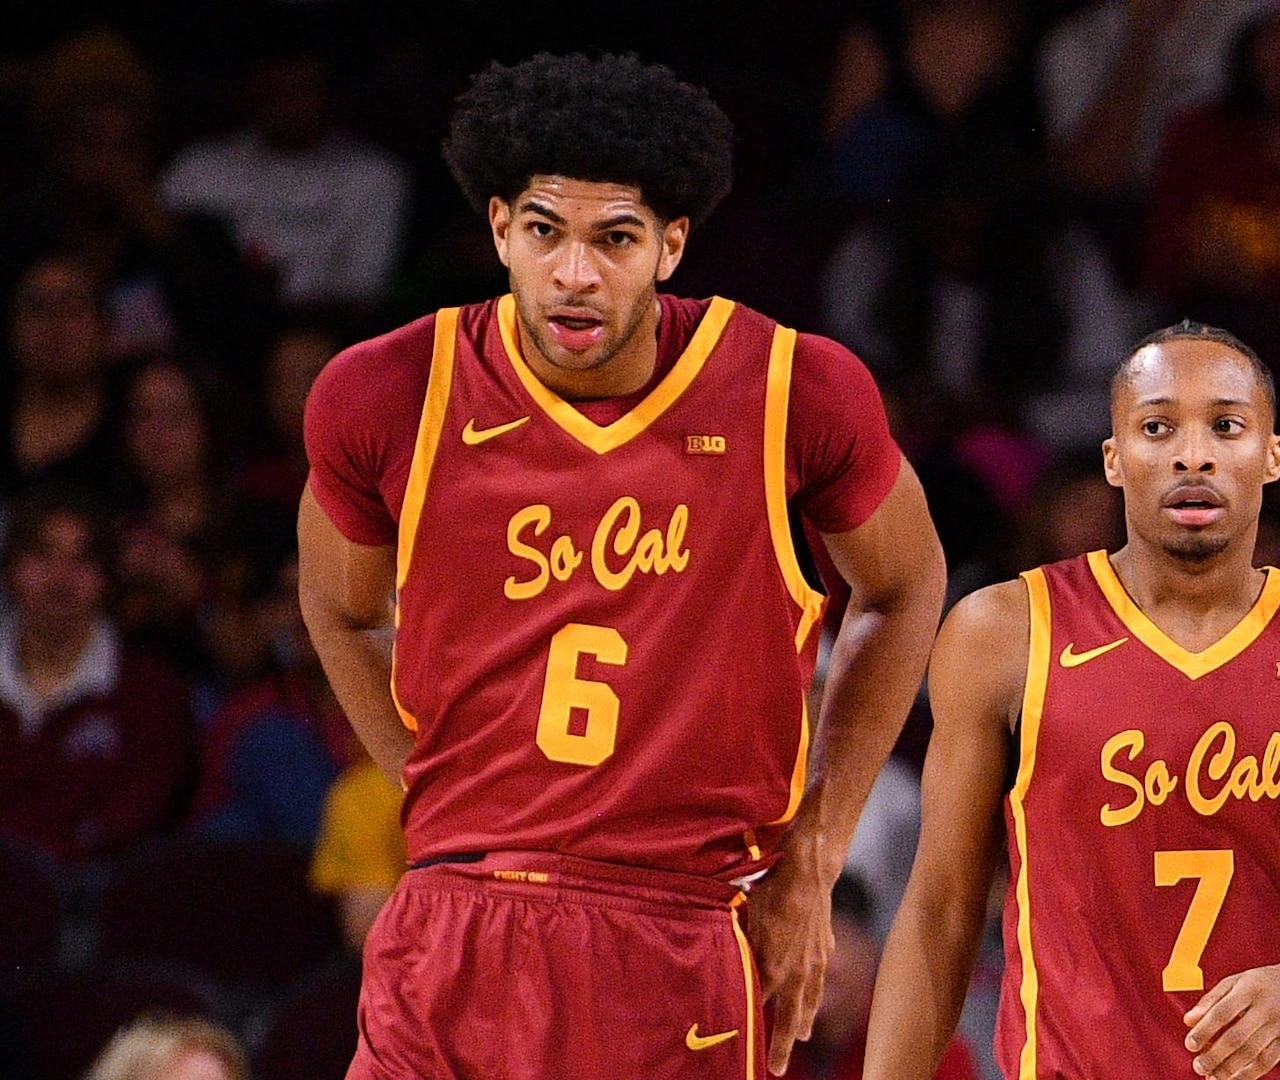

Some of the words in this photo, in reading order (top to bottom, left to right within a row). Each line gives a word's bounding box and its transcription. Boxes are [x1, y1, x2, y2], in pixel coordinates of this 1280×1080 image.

[504, 504, 584, 600] So
[591, 496, 690, 591] Cal
[536, 622, 628, 767] 6
[1100, 729, 1178, 827] So
[1154, 849, 1234, 992] 7
